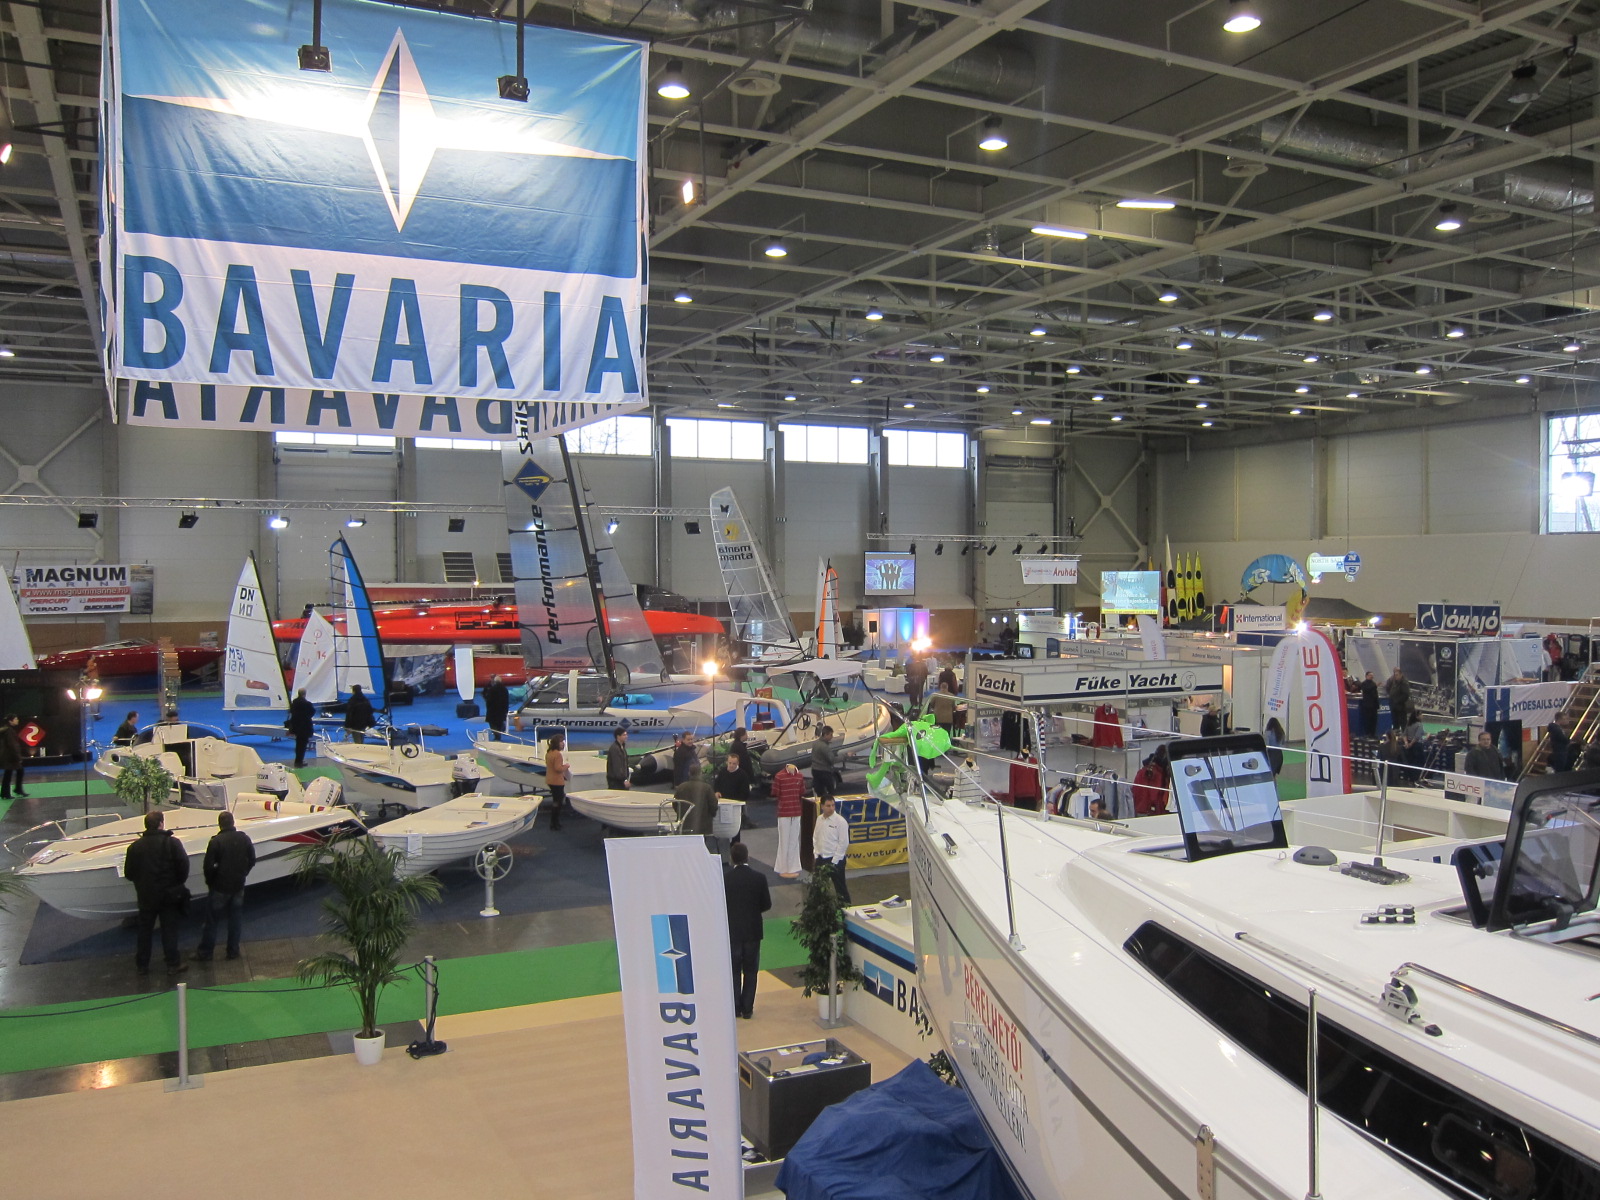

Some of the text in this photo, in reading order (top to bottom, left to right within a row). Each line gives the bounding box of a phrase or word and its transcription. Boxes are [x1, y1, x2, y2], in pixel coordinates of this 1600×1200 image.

[122, 254, 639, 394] BAVARIA
[720, 553, 754, 561] manta
[25, 566, 126, 582] MAGNUM
[532, 504, 562, 644] Performance
[239, 587, 255, 601] DN
[1242, 613, 1283, 621] International
[317, 650, 327, 660] 14
[977, 673, 1016, 693] Yacht
[1075, 673, 1178, 691] Füke Yacht
[532, 717, 665, 727] Performance Sails
[846, 848, 908, 859] ww.vetus.n
[964, 963, 1023, 1080] BÉRELHETŐ!
